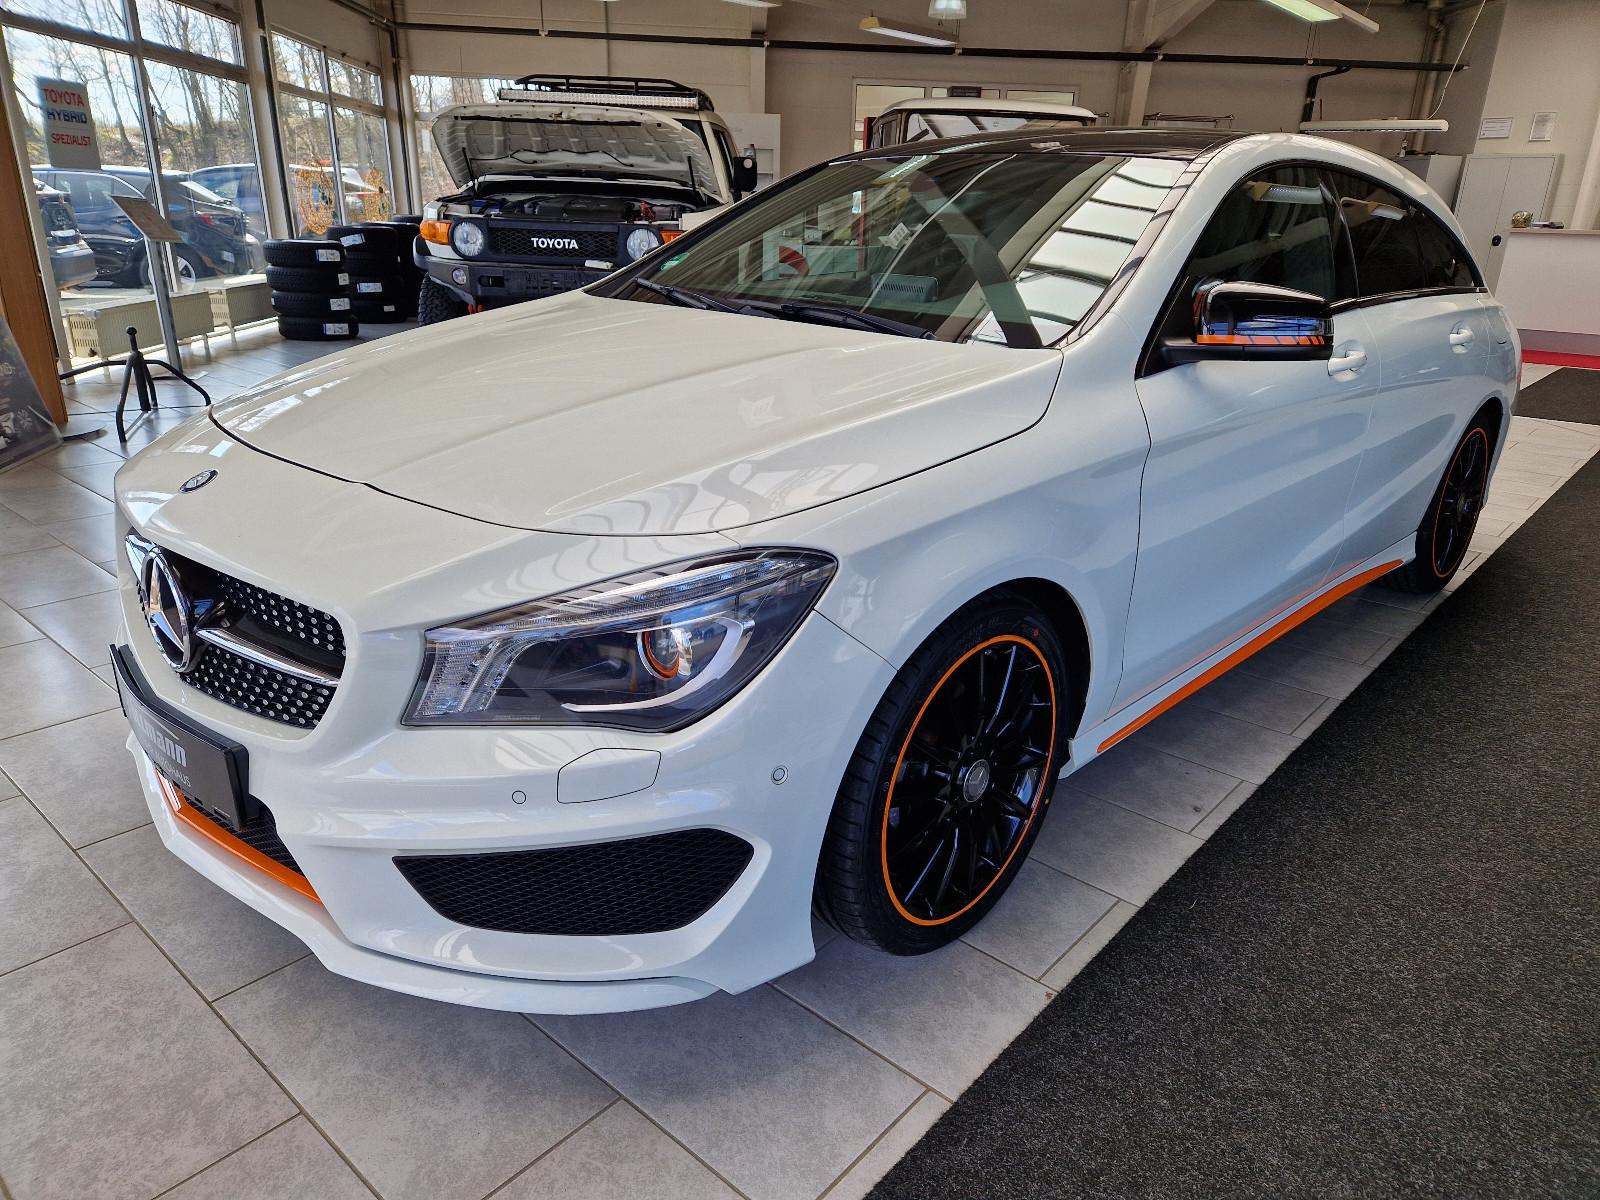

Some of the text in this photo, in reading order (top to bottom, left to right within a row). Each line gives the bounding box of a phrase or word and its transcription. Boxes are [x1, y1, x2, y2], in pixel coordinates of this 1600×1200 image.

[43, 88, 84, 107] TOYOTA
[47, 109, 87, 124] HYBRID
[51, 133, 91, 146] SPEZIALIST
[531, 237, 578, 249] TOYOTA
